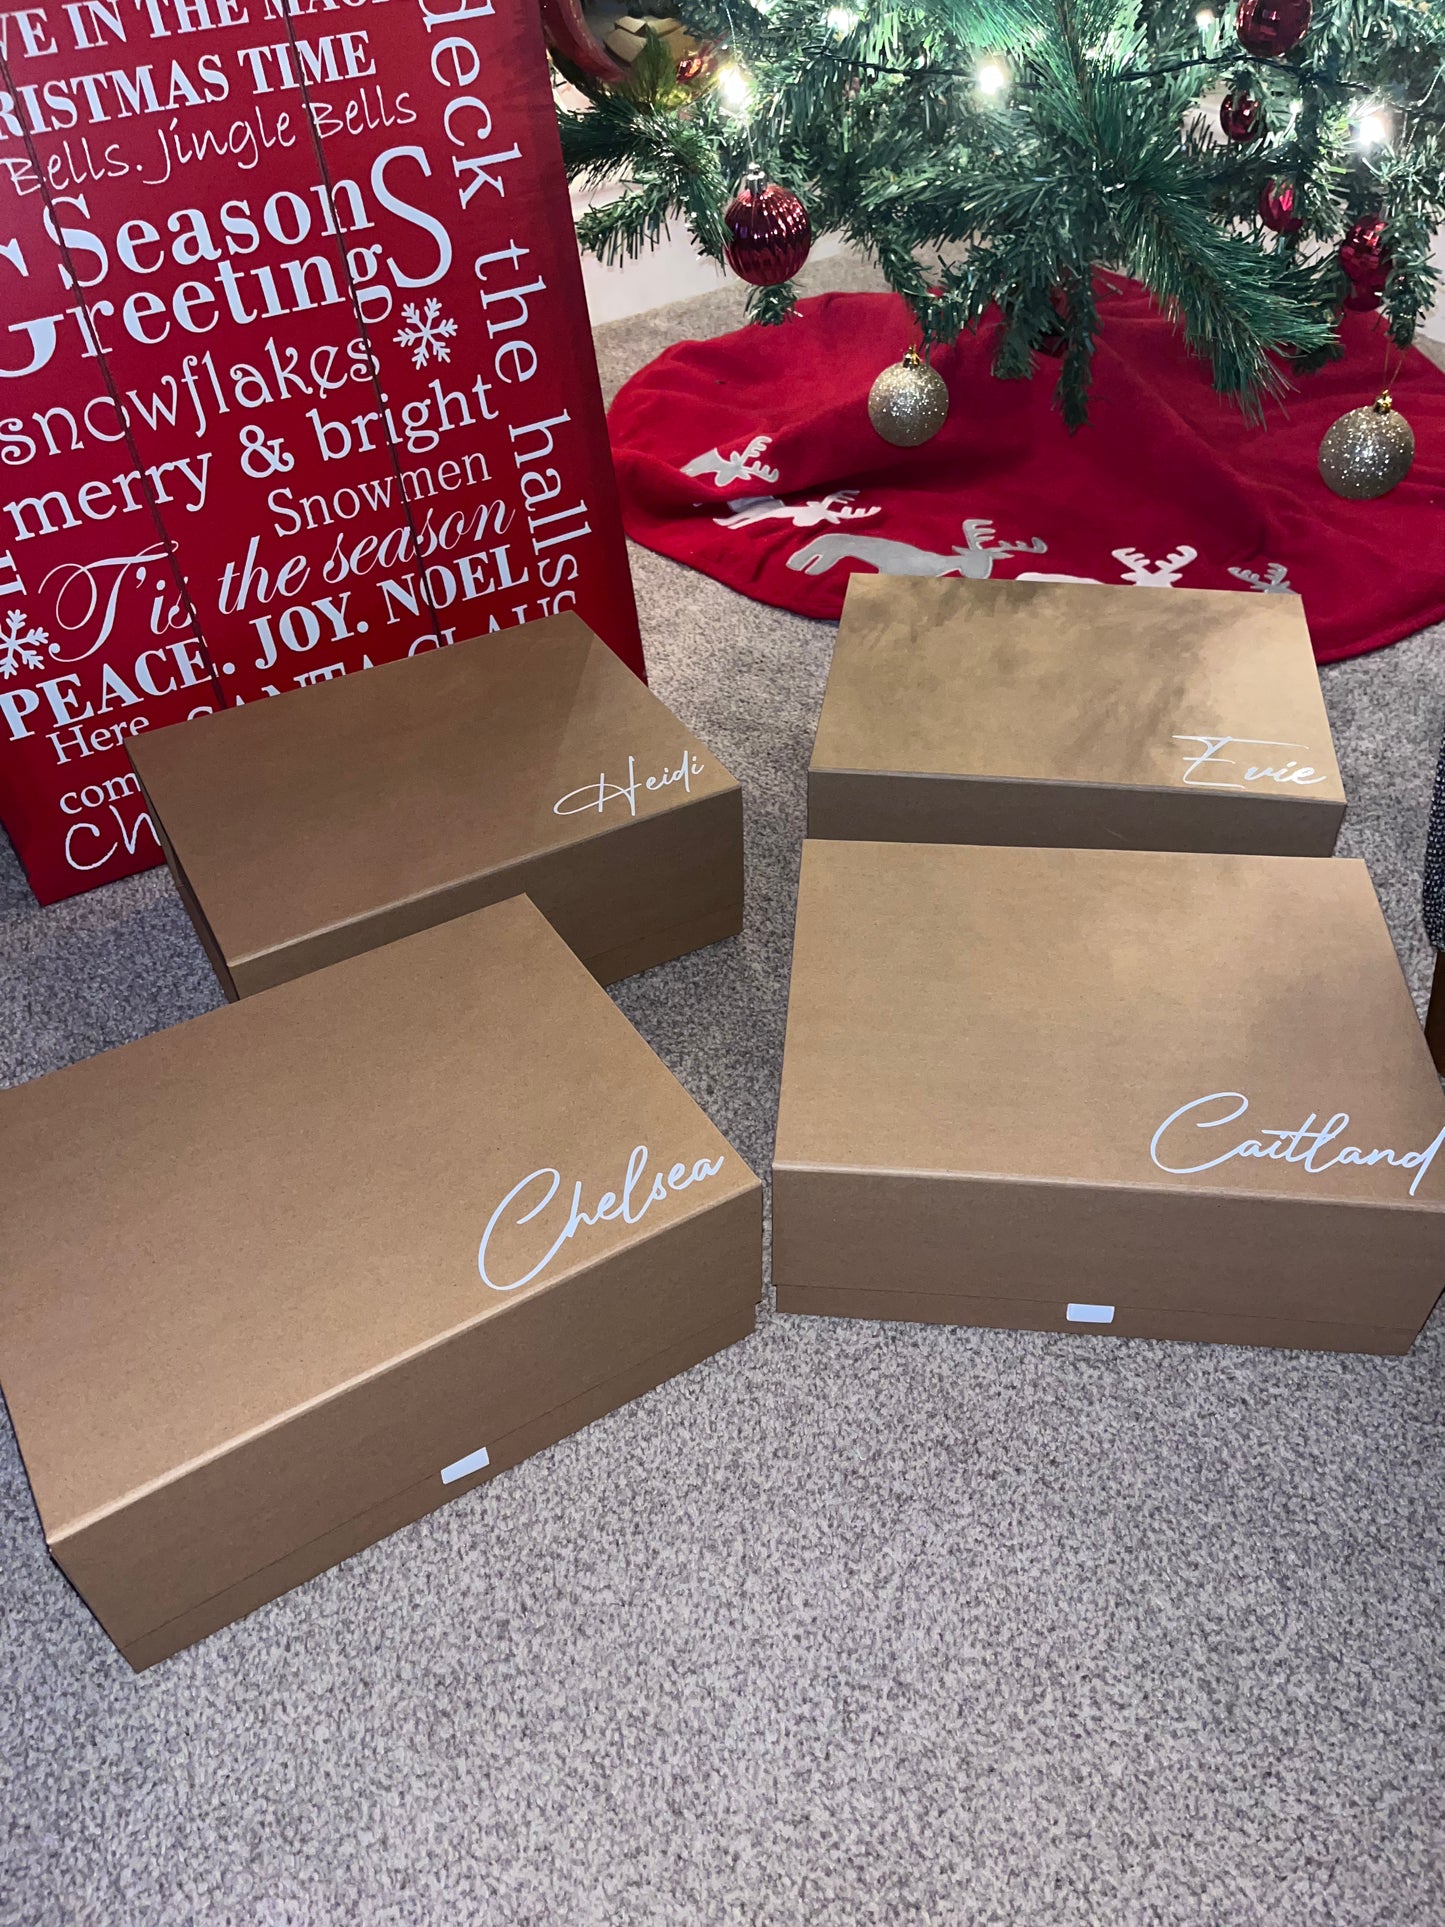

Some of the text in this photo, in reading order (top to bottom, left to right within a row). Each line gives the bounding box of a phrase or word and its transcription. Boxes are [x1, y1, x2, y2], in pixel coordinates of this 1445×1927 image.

[62, 0, 126, 49] IN
[135, 0, 249, 38] THE
[0, 31, 376, 140] RISTMAS TIME
[0, 85, 417, 196] Bells. Jingle Bells
[475, 239, 547, 384] the
[0, 337, 380, 466] snowflakes
[3, 374, 499, 541] merry & bright
[268, 452, 492, 538] Snowmen
[509, 409, 592, 587] halls
[217, 535, 311, 615] the
[322, 499, 516, 584] season
[0, 635, 236, 741] PEACE.
[249, 591, 369, 669] JOY.
[376, 544, 529, 625] NOEL
[553, 750, 705, 816] Heidi
[1172, 736, 1327, 789] Evie
[478, 1145, 725, 1291] Chelsea
